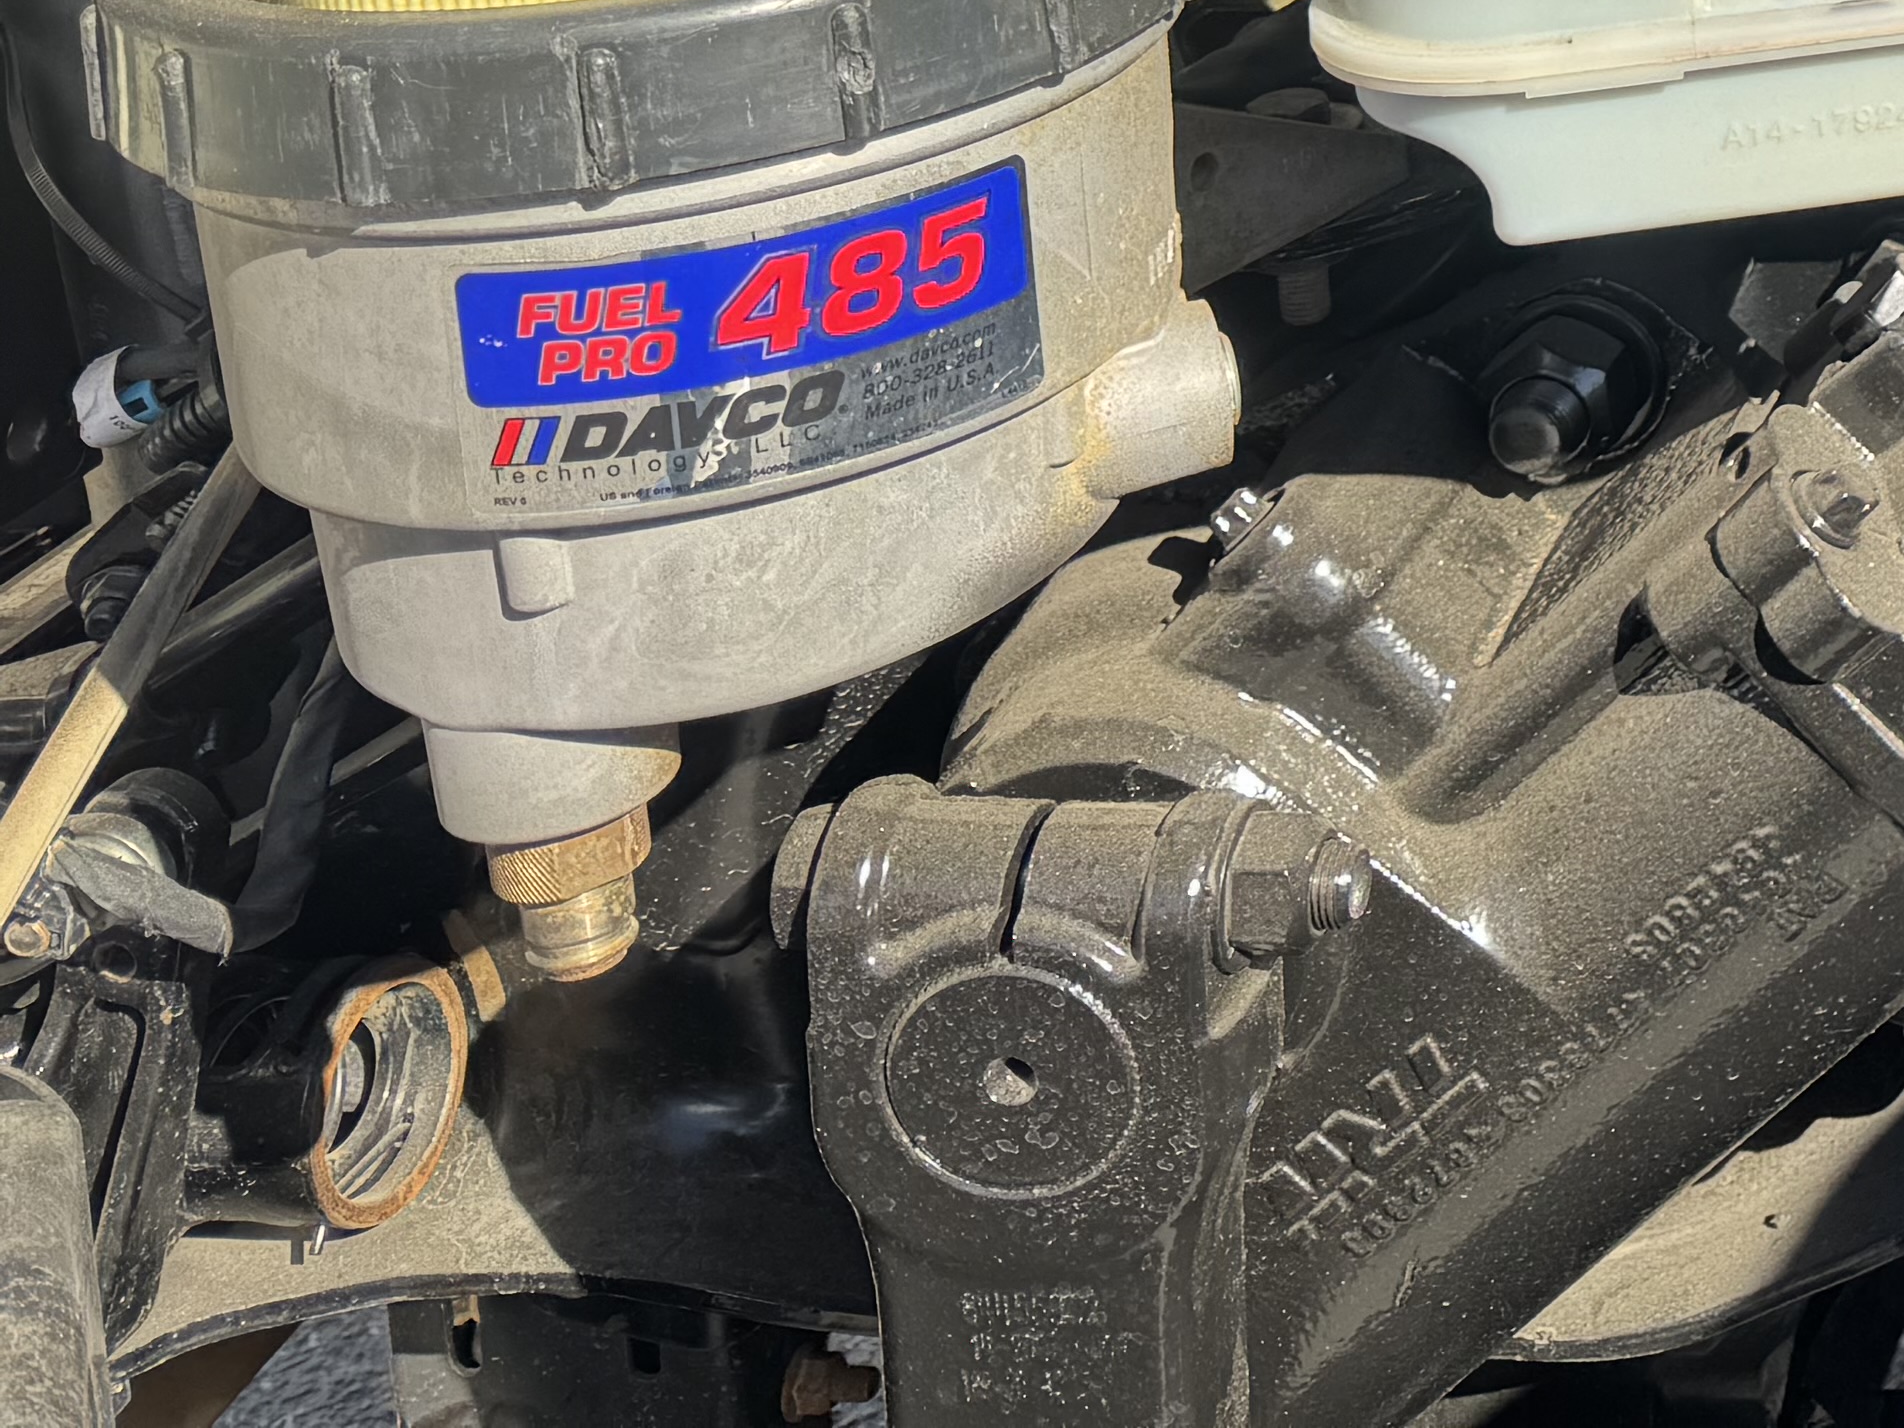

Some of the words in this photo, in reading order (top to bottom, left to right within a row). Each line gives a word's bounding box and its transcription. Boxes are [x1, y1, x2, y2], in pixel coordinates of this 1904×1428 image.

[710, 193, 990, 360] 485
[516, 280, 682, 338] FUEL
[537, 331, 677, 386] PRO
[861, 322, 996, 379] www.davco.com
[863, 341, 994, 400] 800-328-2611
[560, 370, 848, 463] DAVCO
[865, 394, 916, 420] Made
[923, 386, 938, 402] in
